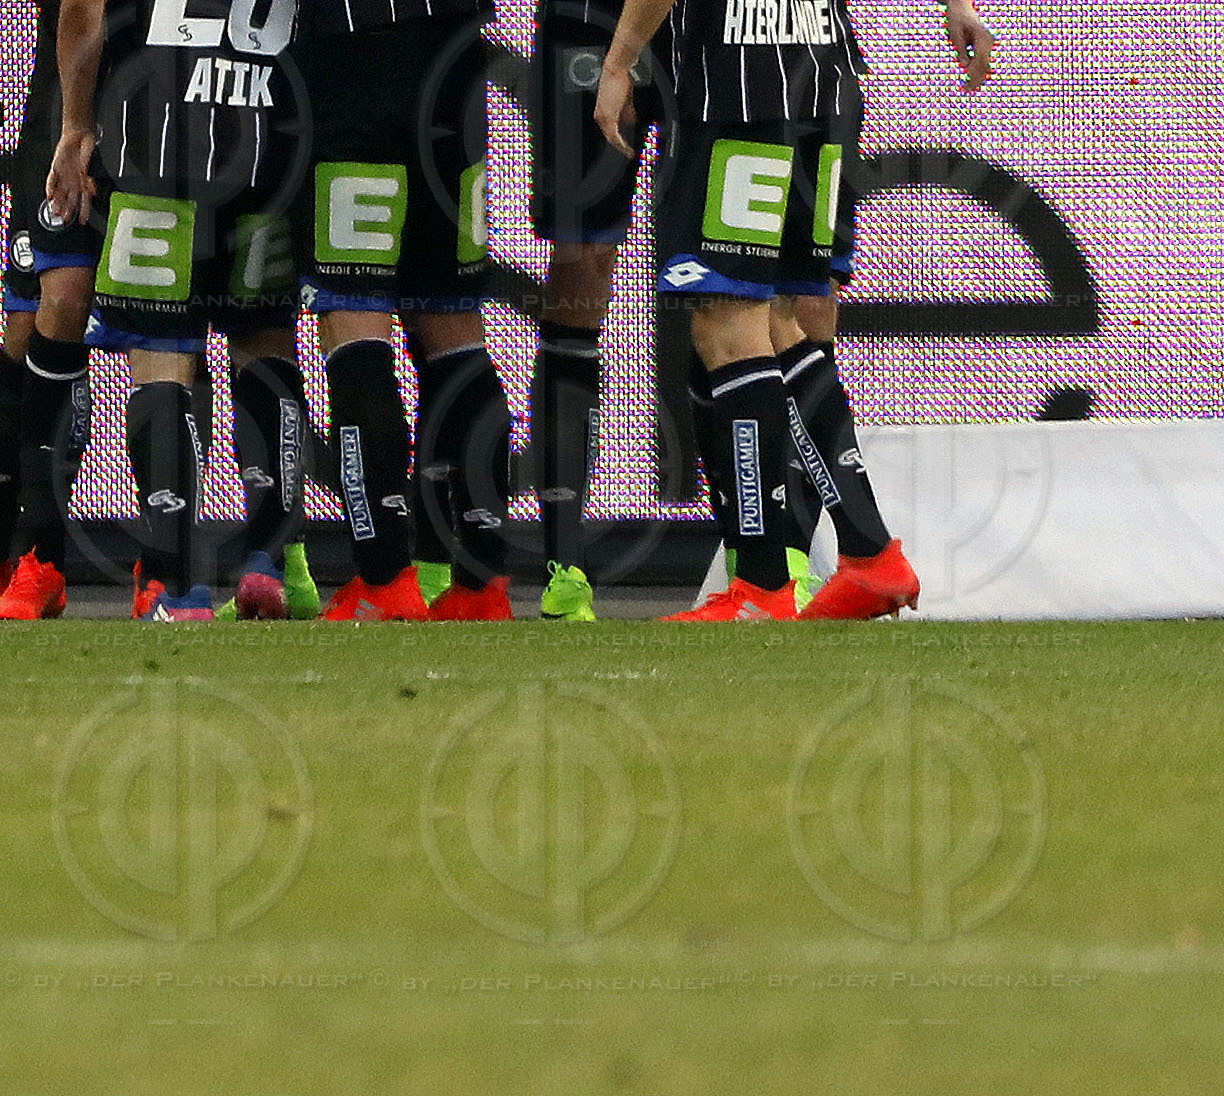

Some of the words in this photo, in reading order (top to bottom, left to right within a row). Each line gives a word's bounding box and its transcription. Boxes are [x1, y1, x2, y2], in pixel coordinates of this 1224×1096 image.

[183, 57, 274, 108] ATIK
[329, 176, 400, 251] E
[721, 154, 791, 231] E
[108, 207, 177, 287] E
[343, 431, 373, 533] PUNTIGAMER
[739, 423, 760, 531] PUNTIGAMER
